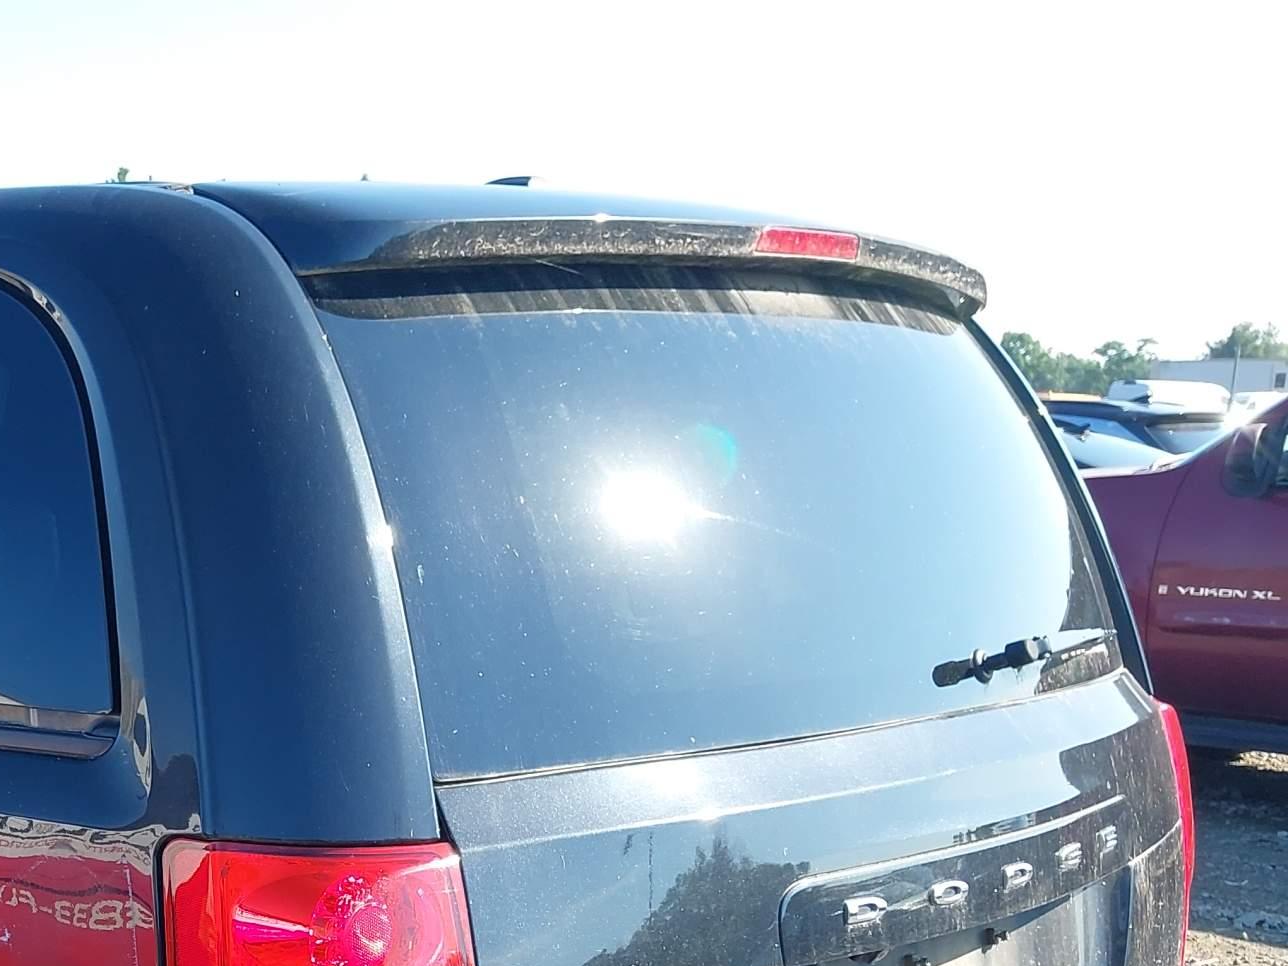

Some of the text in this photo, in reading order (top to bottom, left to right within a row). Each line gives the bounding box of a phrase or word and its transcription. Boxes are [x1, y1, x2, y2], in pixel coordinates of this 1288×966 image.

[1176, 586, 1281, 601] YUKON XL
[843, 825, 1121, 926] DODGE
